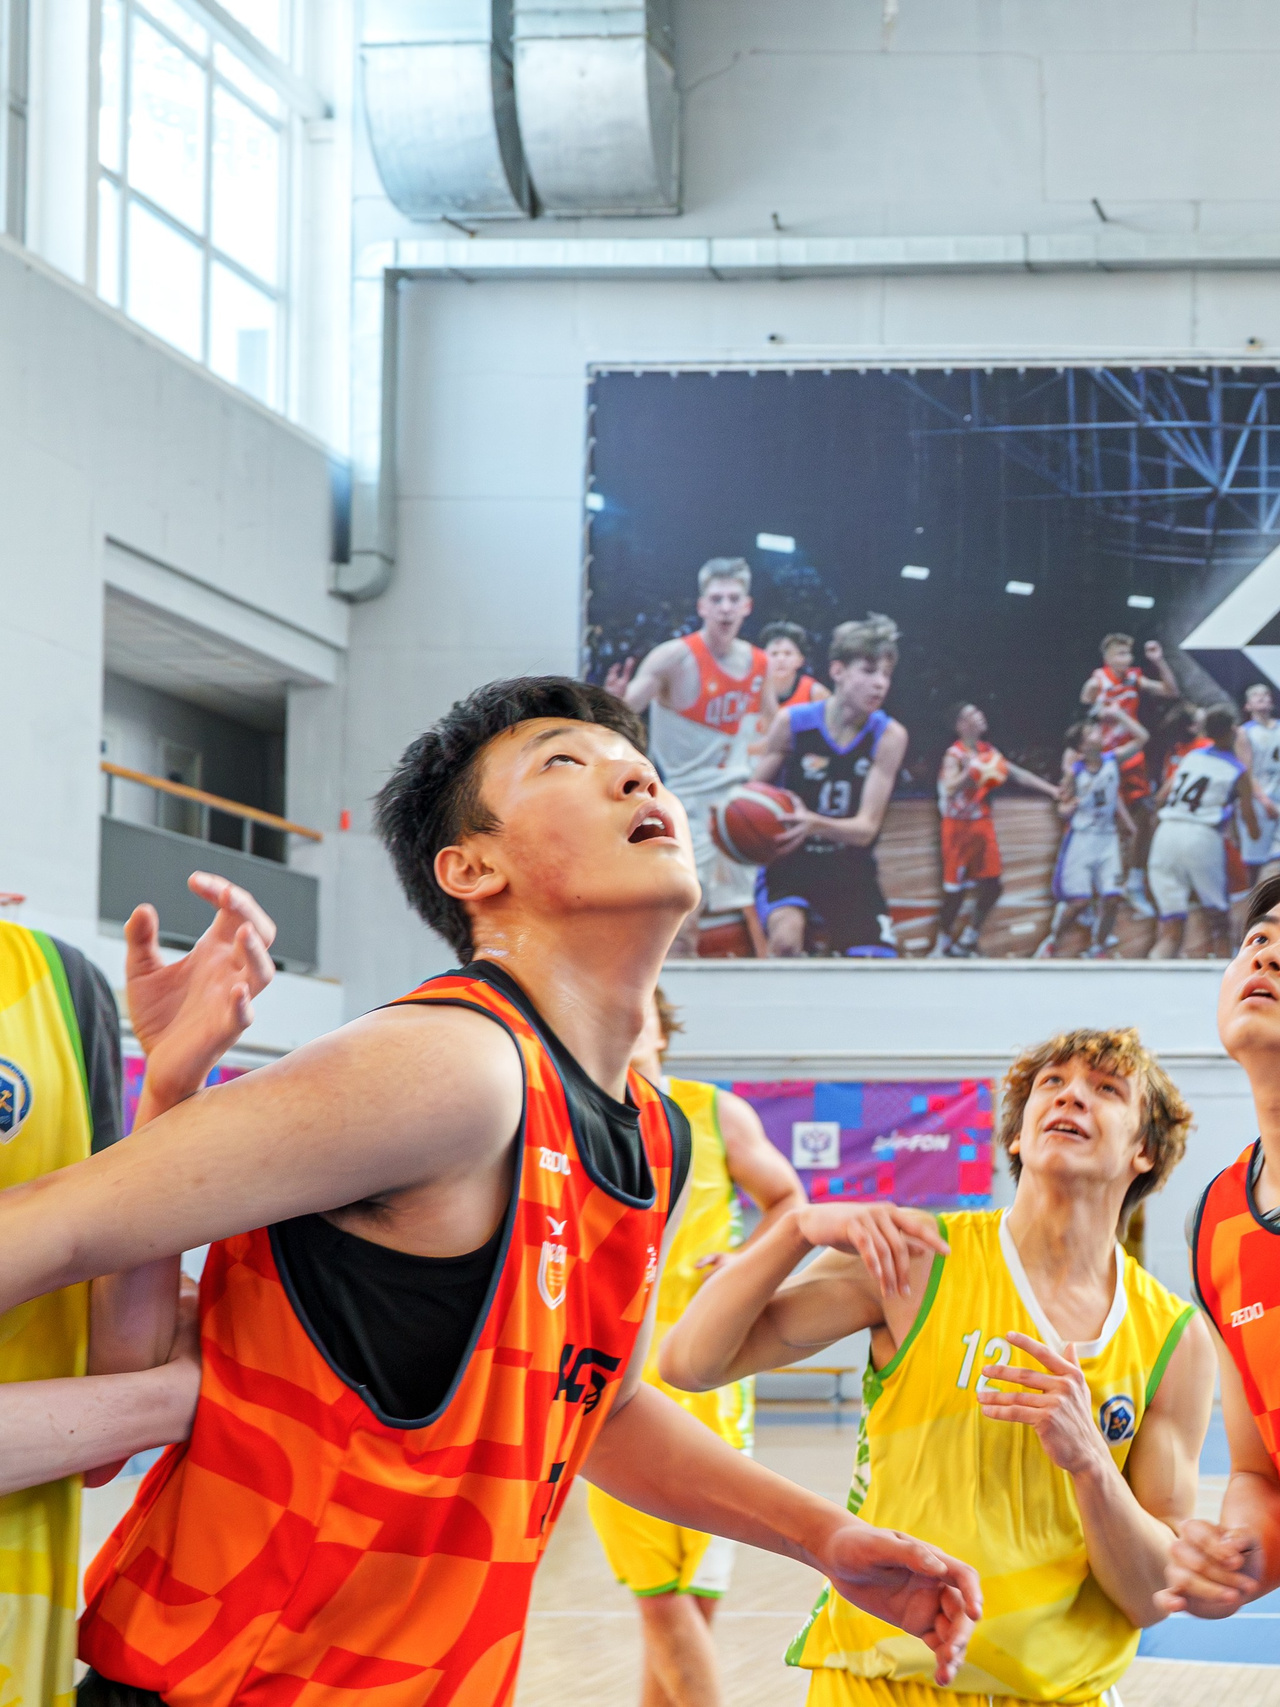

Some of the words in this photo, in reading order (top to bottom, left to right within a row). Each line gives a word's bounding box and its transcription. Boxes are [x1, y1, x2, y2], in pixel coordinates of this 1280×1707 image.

[818, 780, 852, 817] 13
[1170, 772, 1212, 813] 14
[1230, 1302, 1265, 1328] ZEDO
